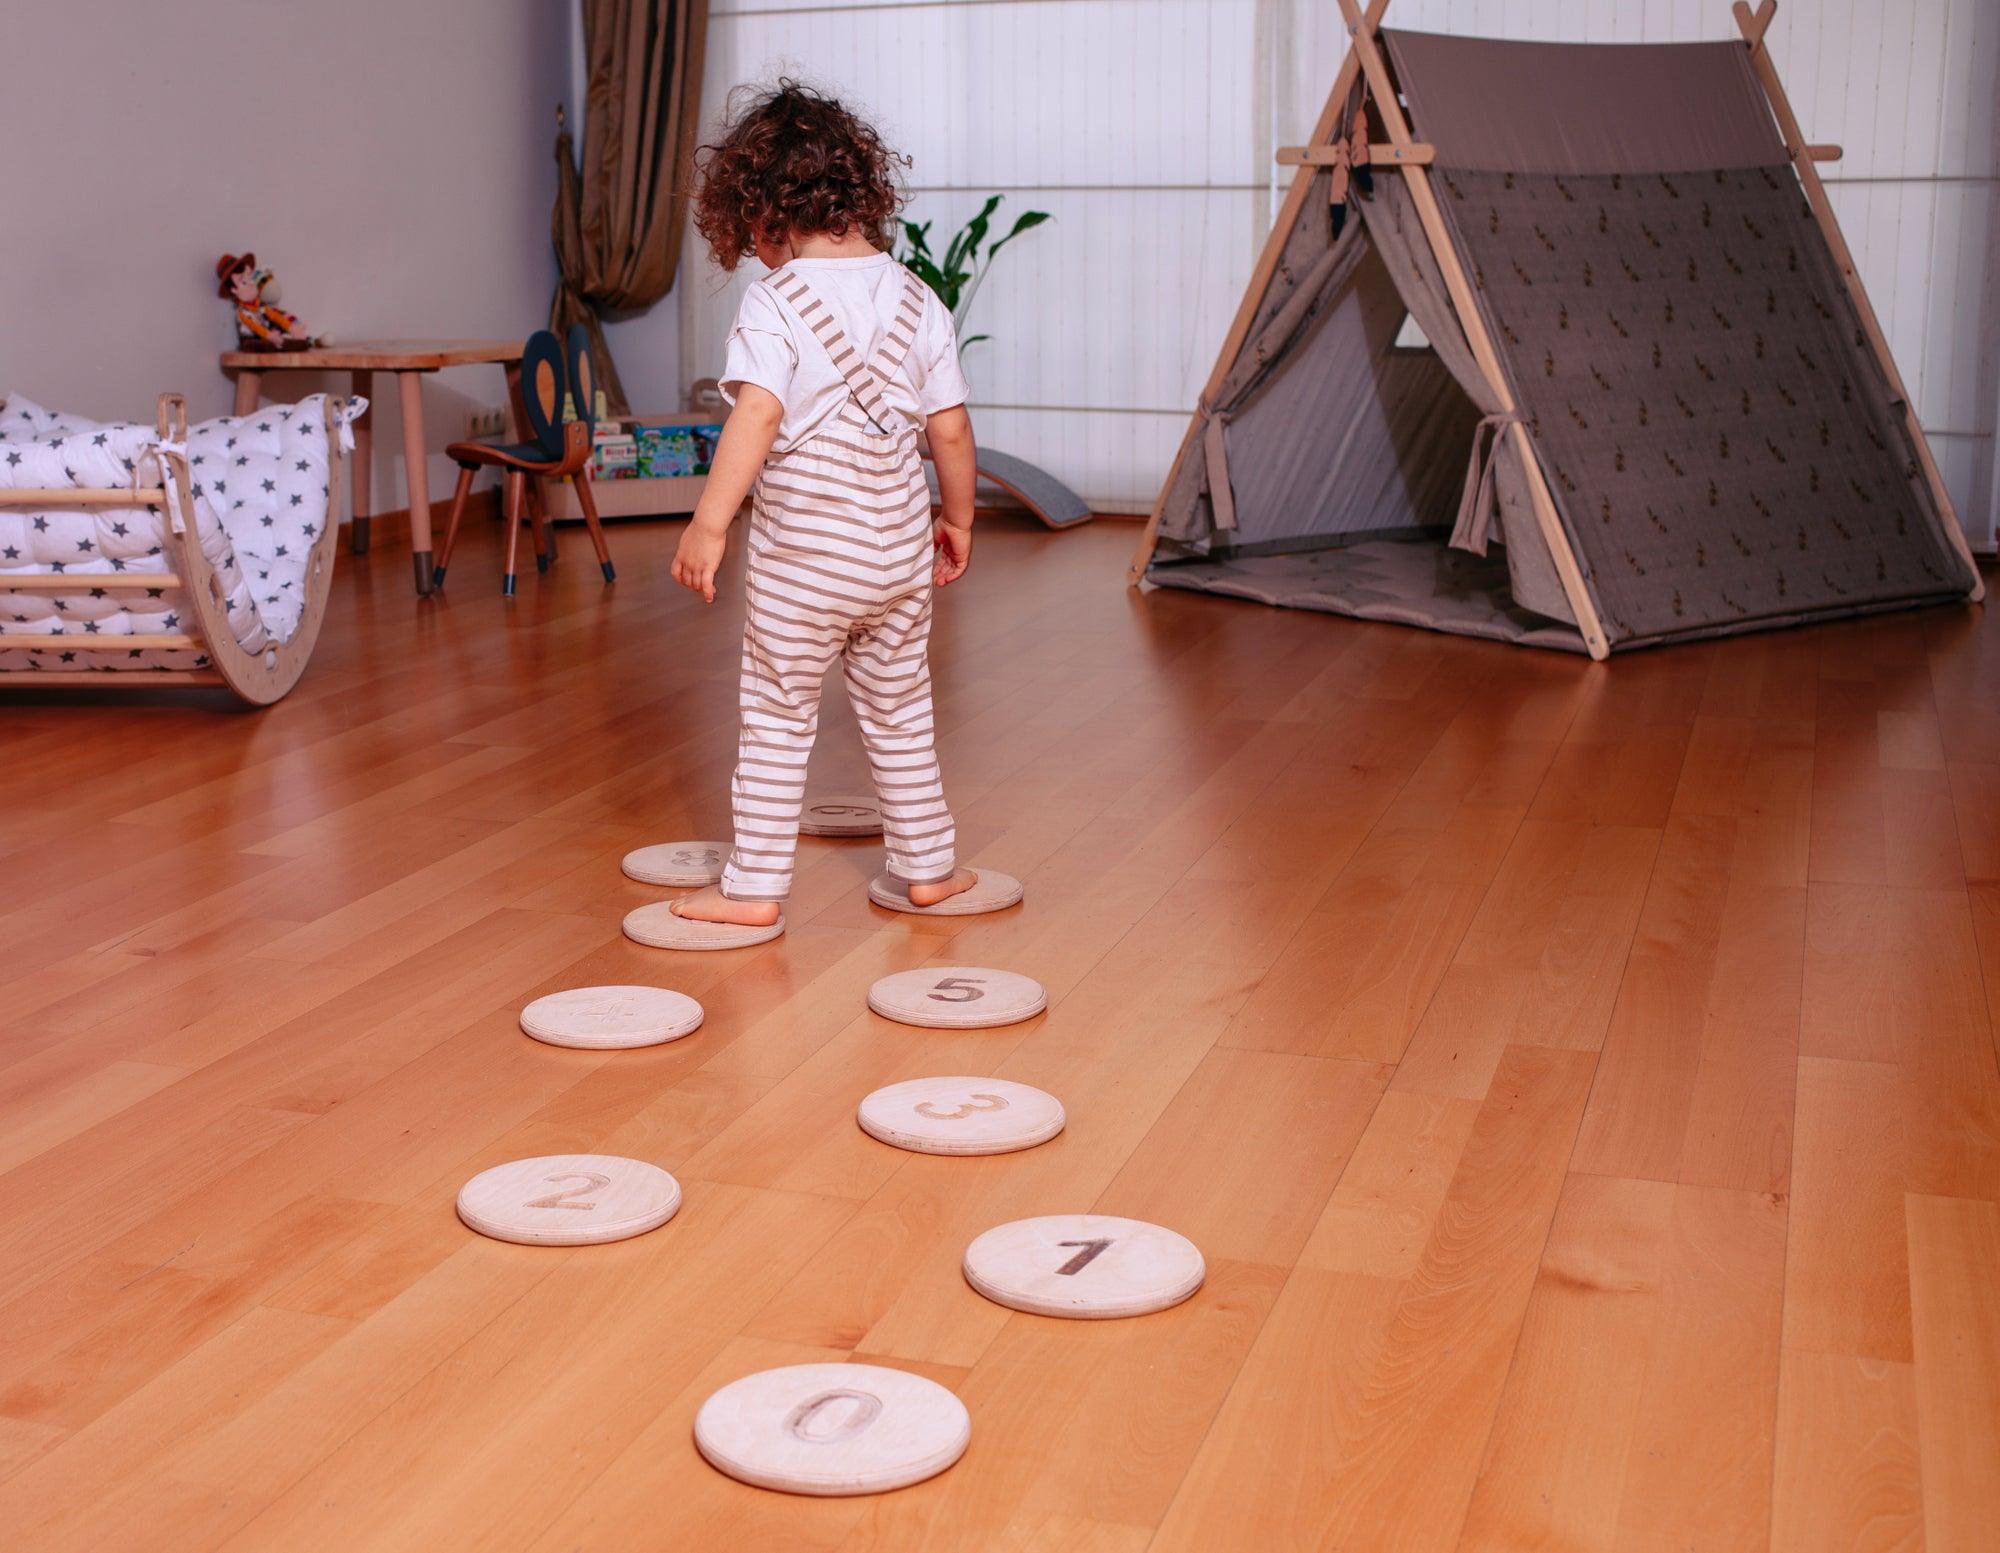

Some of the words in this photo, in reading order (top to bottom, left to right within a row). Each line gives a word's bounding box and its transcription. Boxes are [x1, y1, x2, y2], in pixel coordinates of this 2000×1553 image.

[671, 848, 720, 867] 8
[927, 977, 987, 1002] 5
[913, 1093, 1010, 1120] 3
[523, 1171, 611, 1210] 2
[1054, 1237, 1116, 1276] 1
[783, 1387, 883, 1444] 0
